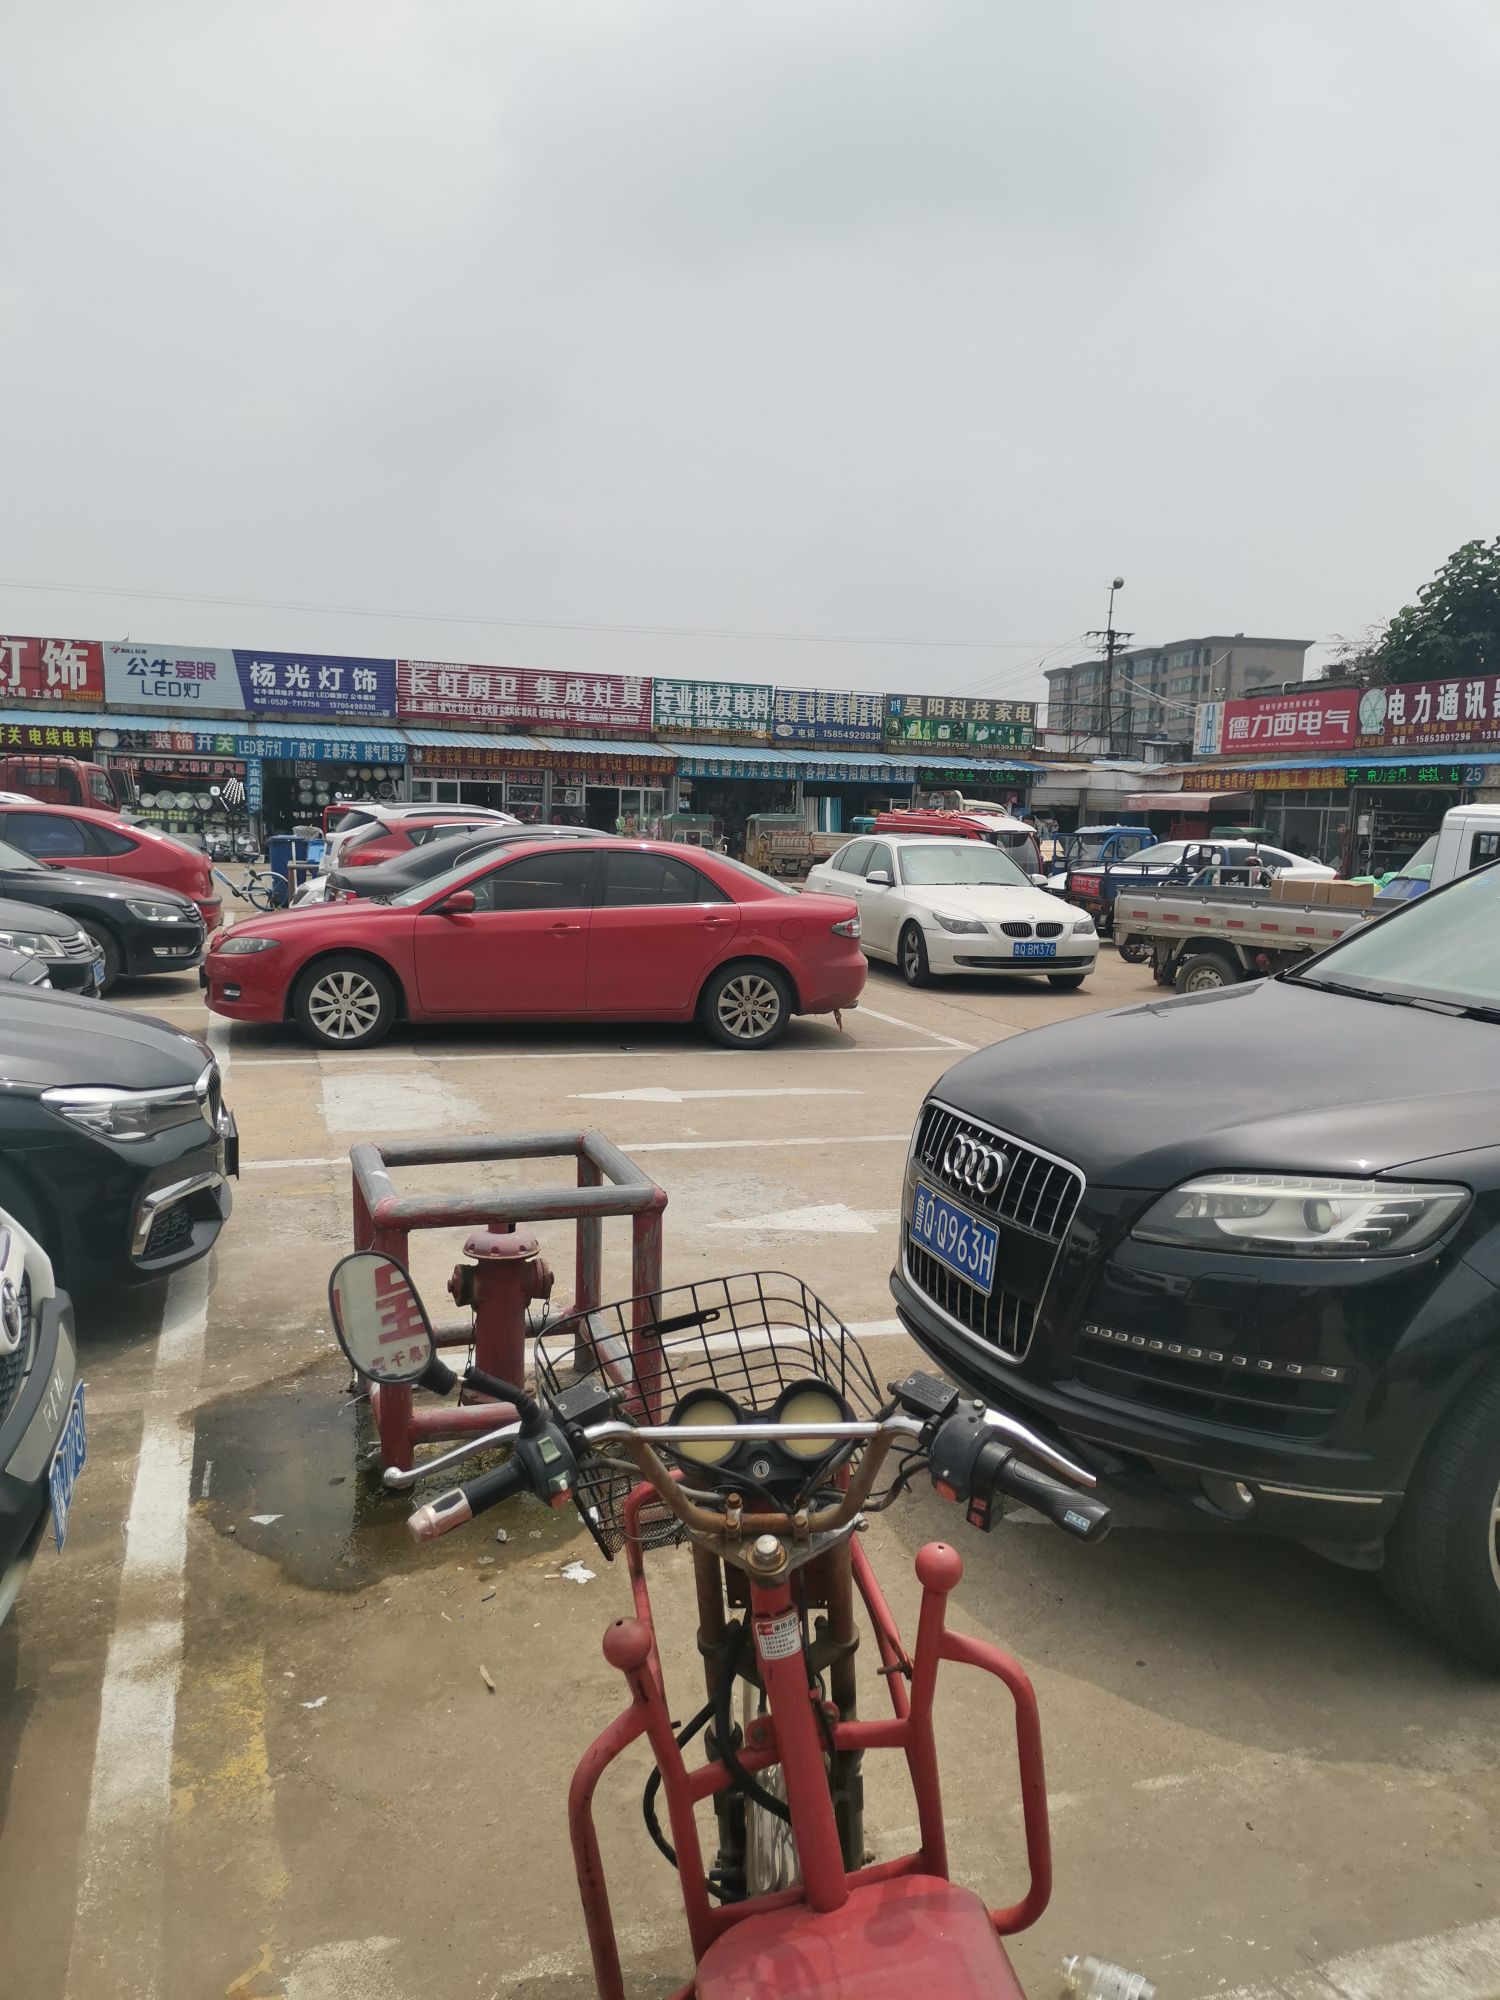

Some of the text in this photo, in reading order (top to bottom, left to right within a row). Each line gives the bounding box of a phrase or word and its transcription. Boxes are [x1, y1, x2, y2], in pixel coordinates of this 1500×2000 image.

[127, 657, 217, 681] 公牛爱眼
[250, 661, 378, 693] 杨光灯饰
[142, 680, 201, 699] LED灯
[408, 667, 518, 700] 长虹厨卫
[534, 676, 645, 710] 集成灶具
[656, 682, 769, 719] 专业批发电料
[904, 697, 1032, 723] 昊阳科技家电
[1388, 679, 1500, 725] 电力通讯
[1229, 709, 1350, 739] 德力西电气
[29, 728, 94, 748] 电线电料
[239, 740, 282, 757] LED客厅灯
[289, 742, 316, 758] 厂房灯
[323, 743, 357, 760] 正泰开关
[392, 744, 406, 753] 36
[392, 753, 406, 762] 37
[1465, 767, 1482, 782] 25
